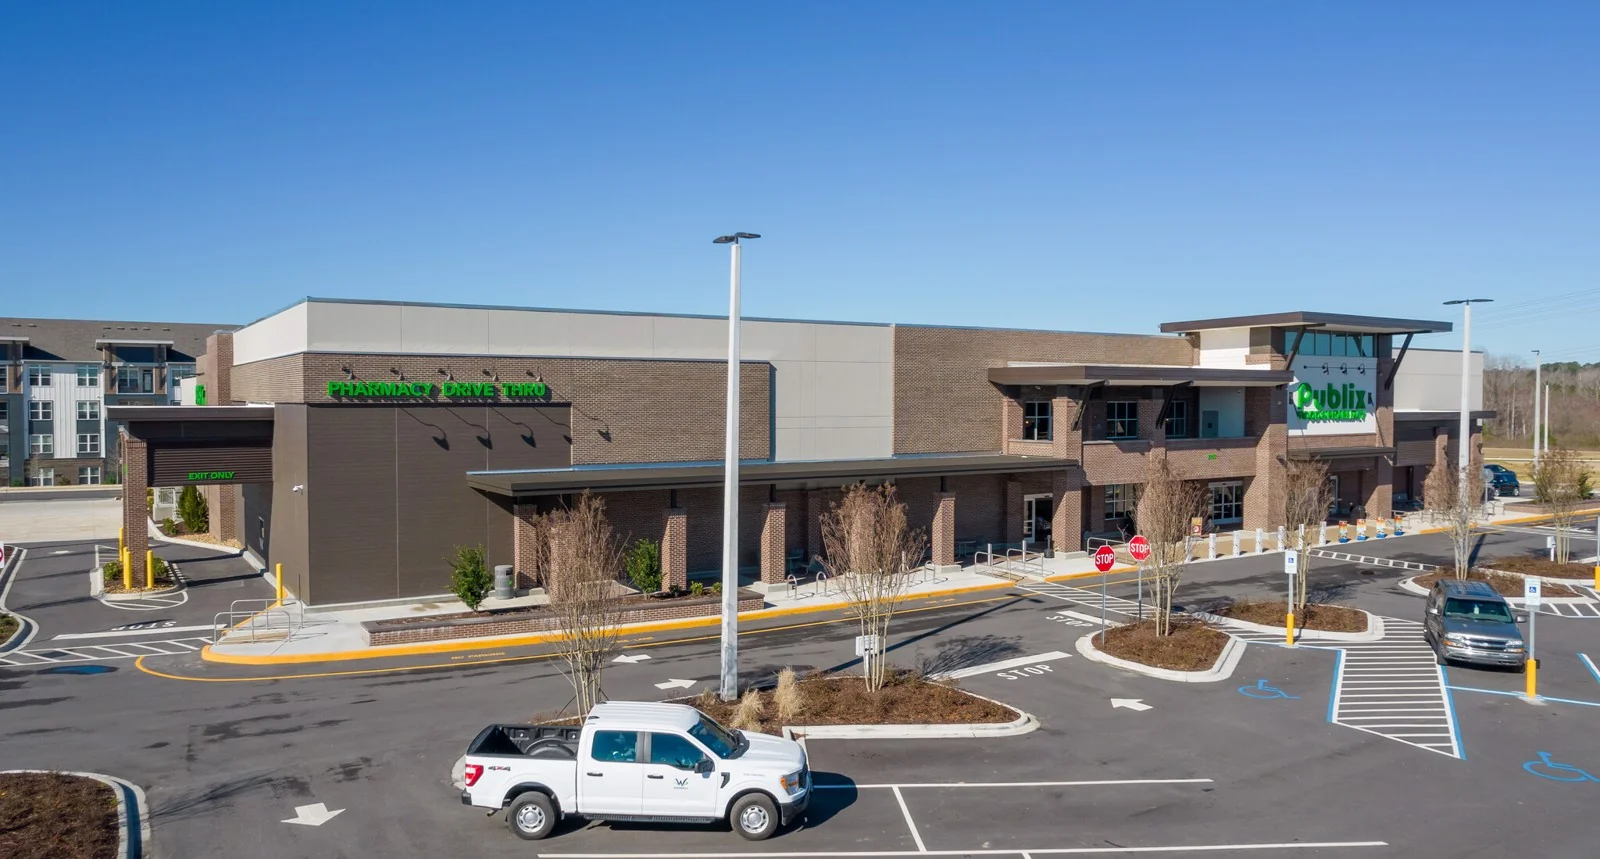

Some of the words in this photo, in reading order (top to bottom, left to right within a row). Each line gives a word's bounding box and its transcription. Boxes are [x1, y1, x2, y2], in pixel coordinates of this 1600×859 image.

[327, 381, 434, 396] PHARMACY
[442, 382, 495, 396] DRIVE
[502, 382, 547, 396] THRU
[1296, 382, 1367, 409] Publix
[188, 472, 209, 480] EXIT
[210, 471, 235, 479] ONLY
[1130, 543, 1149, 553] STOP
[1096, 553, 1114, 565] STOP
[996, 664, 1054, 681] STOP
